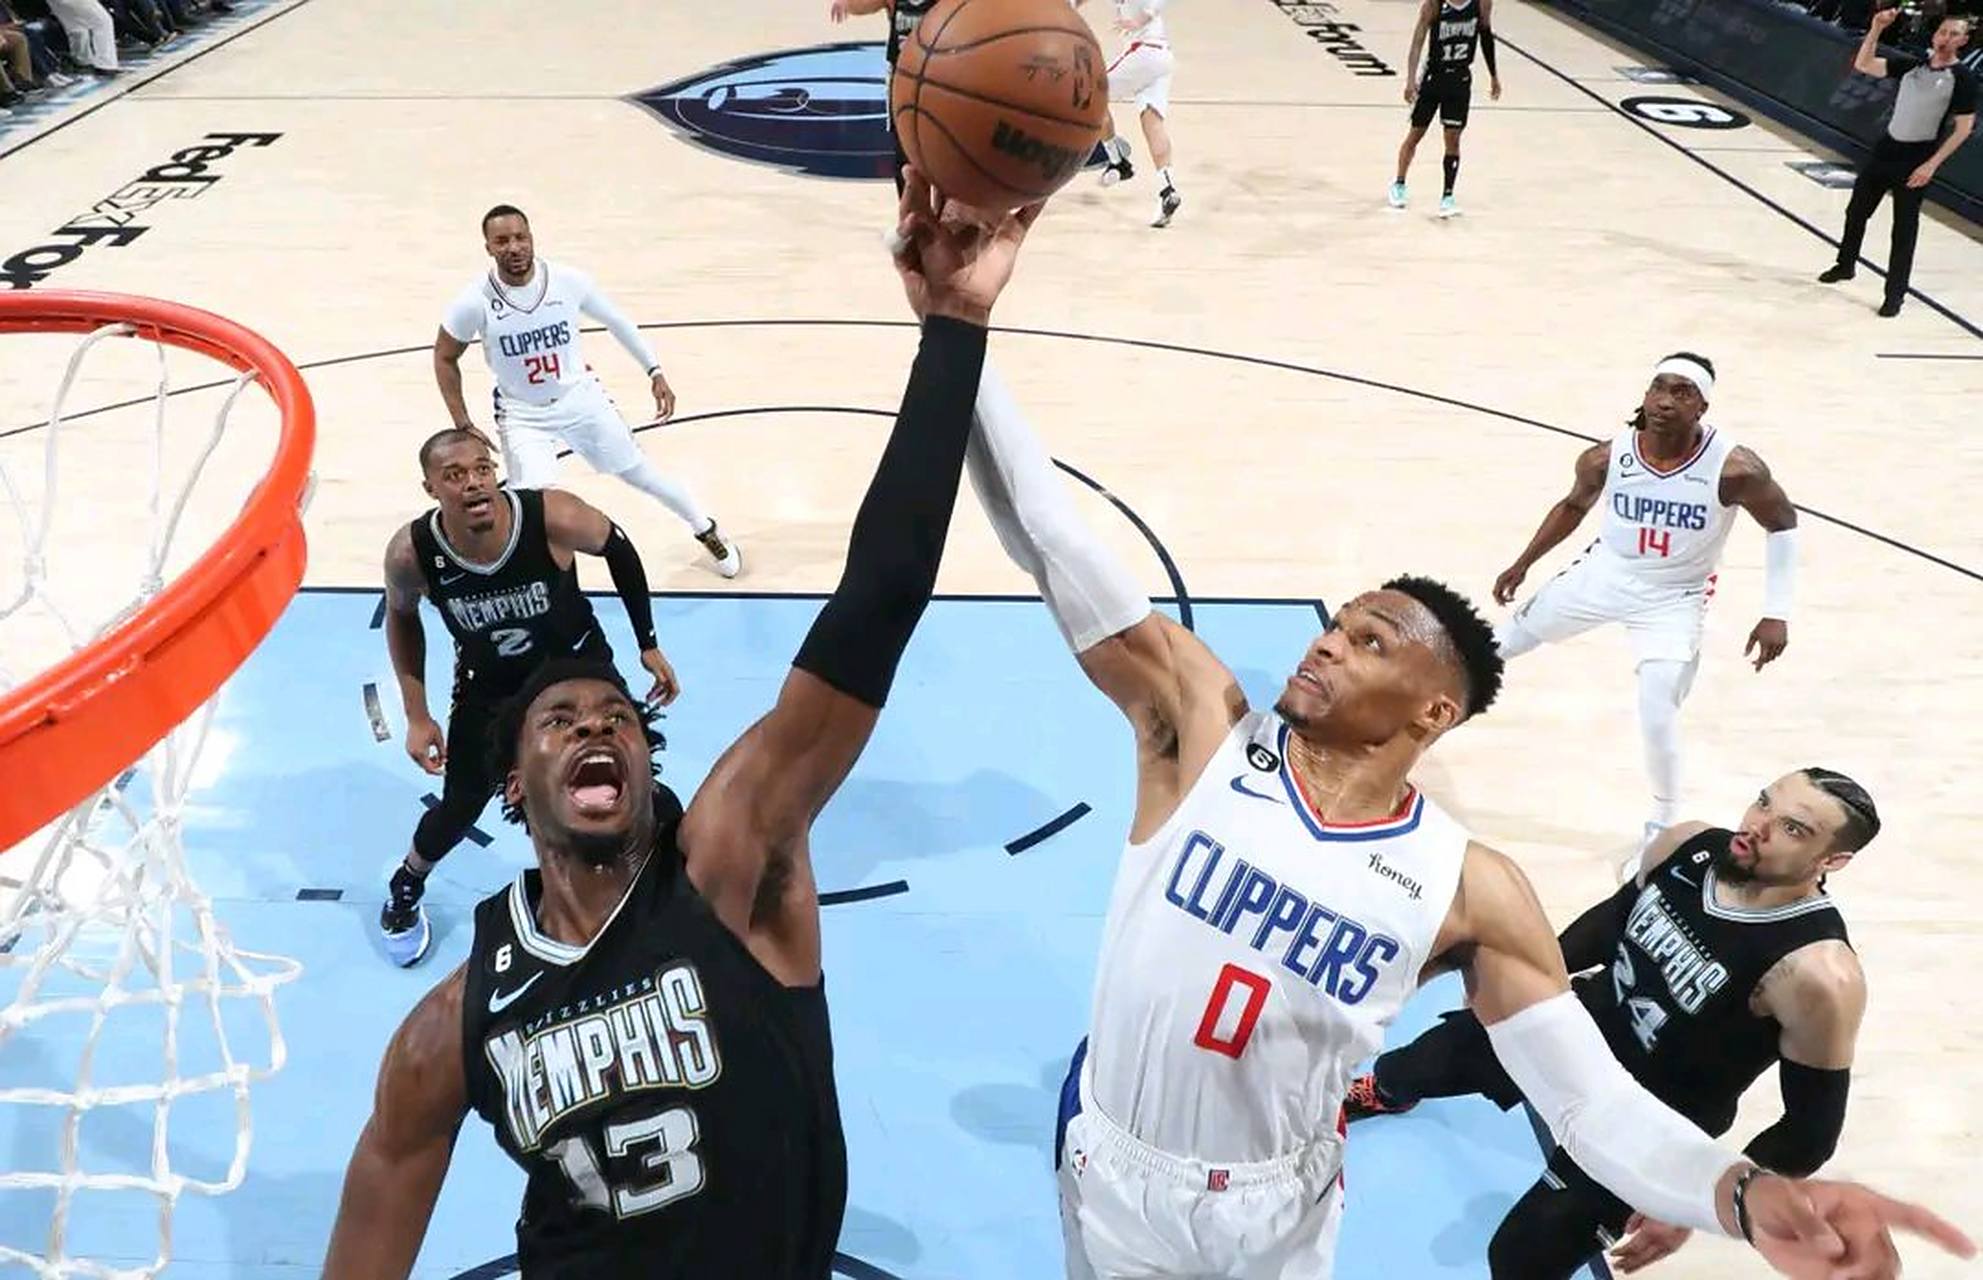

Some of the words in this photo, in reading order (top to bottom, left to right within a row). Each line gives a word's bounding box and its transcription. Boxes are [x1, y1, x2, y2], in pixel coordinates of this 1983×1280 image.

[1442, 43, 1469, 61] 12
[499, 320, 571, 357] CLIPPERS
[524, 352, 561, 384] 24
[1613, 492, 1707, 530] CLIPPERS
[1640, 527, 1670, 557] 14
[448, 581, 549, 631] MEMPHIS
[491, 628, 533, 657] 2
[1250, 748, 1274, 769] 6
[1692, 850, 1710, 865] 6
[1165, 829, 1400, 1005] CLIPPERS
[495, 943, 512, 973] 6
[1625, 883, 1730, 1015] MEMPHIS
[1193, 961, 1272, 1060] 0
[1613, 940, 1670, 1053] 24
[485, 960, 722, 1151] MEMPHIS
[544, 1104, 706, 1220] 13
